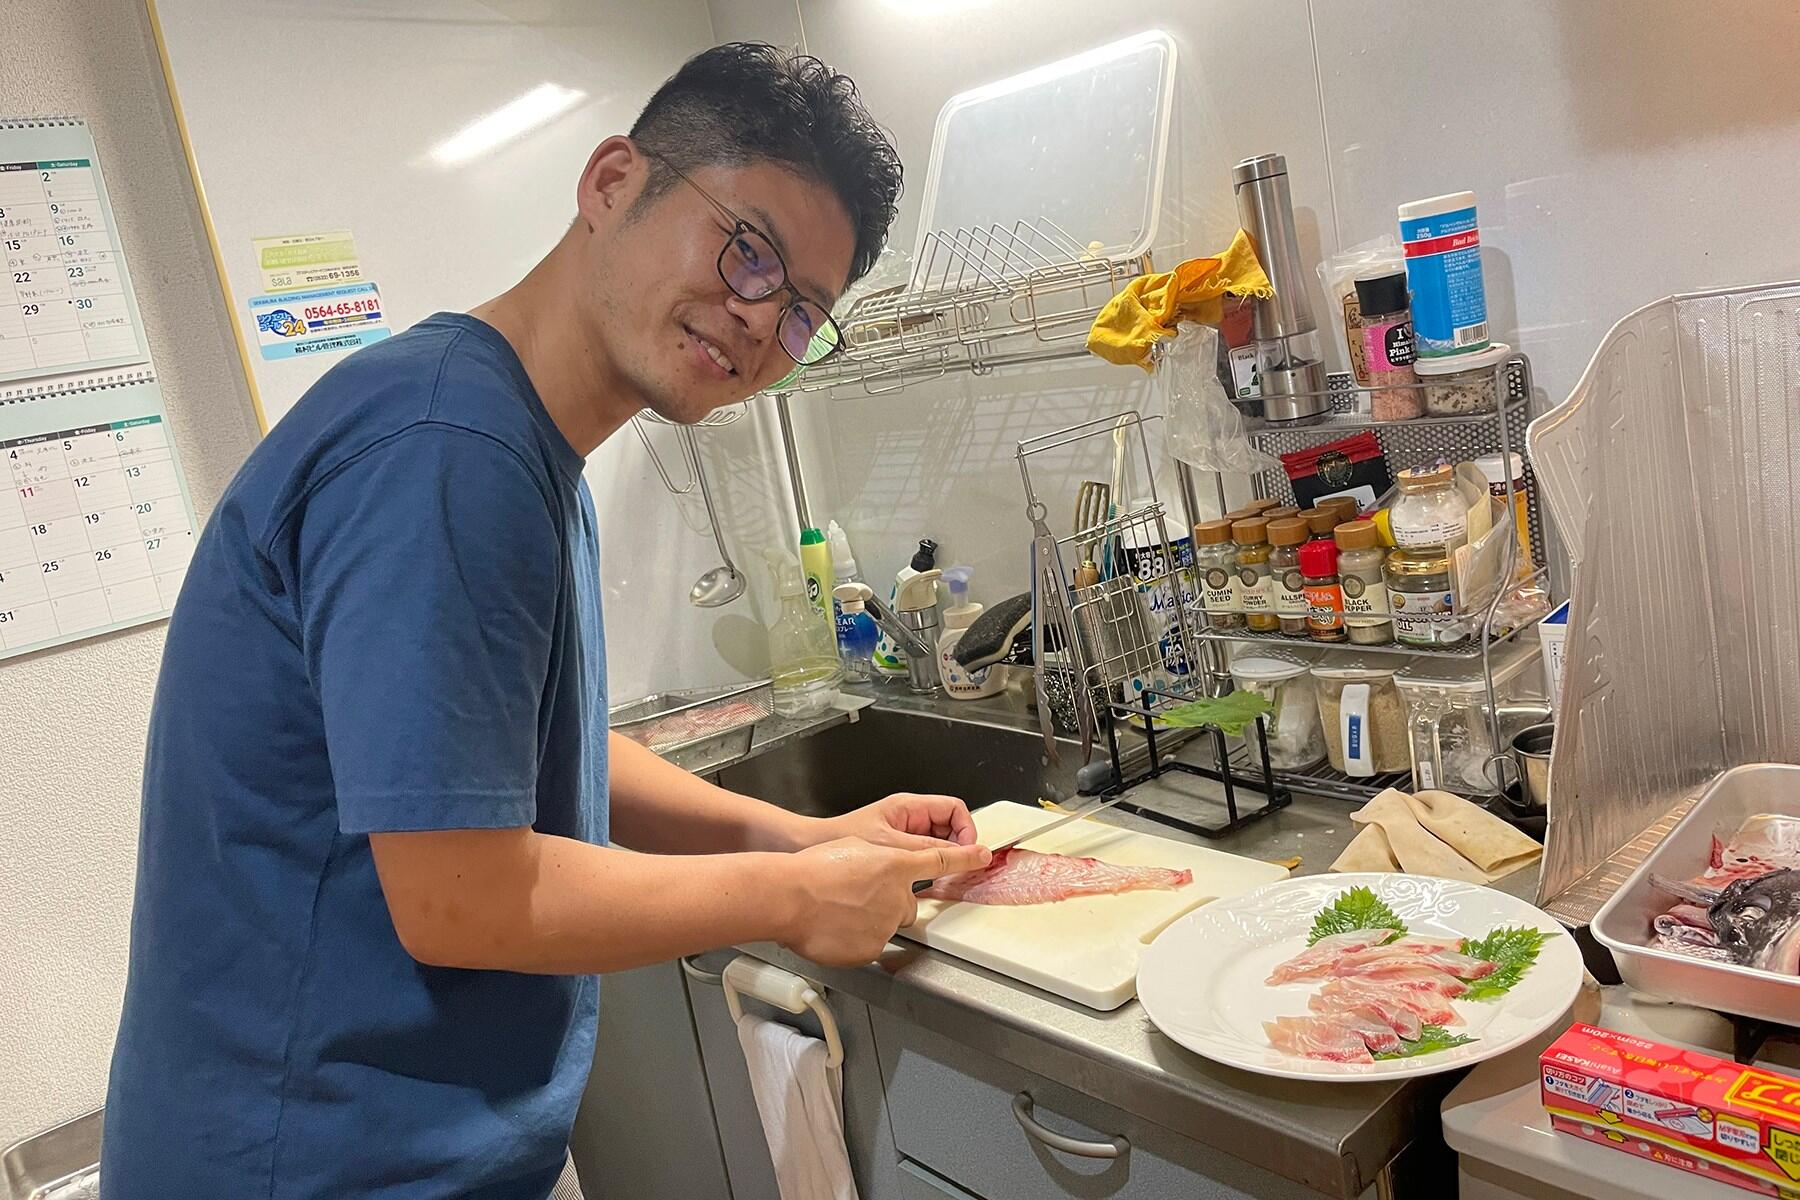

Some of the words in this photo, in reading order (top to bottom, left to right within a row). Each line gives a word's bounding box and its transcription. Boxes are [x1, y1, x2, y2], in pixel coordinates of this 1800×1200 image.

[41, 171, 51, 182] 2
[50, 203, 59, 214] 9
[5, 239, 21, 251] 15
[59, 235, 75, 246] 16
[14, 271, 32, 284] 22
[67, 266, 84, 278] 23
[22, 304, 40, 316] 29
[76, 298, 92, 310] 30
[304, 298, 381, 320] 0564-65-8181
[283, 318, 307, 337] 24
[1396, 328, 1405, 340] I
[1389, 345, 1411, 357] Pink
[80, 427, 97, 435] Friday
[116, 431, 124, 442] 6
[23, 435, 47, 445] Thursday
[63, 440, 72, 451] 5
[10, 450, 18, 460] 4
[126, 467, 141, 479] 13
[74, 476, 90, 488] 12
[20, 486, 35, 498] 11
[136, 502, 152, 515] 20
[84, 513, 100, 525] 19
[31, 523, 48, 537] 18
[146, 538, 161, 551] 27
[95, 548, 112, 562] 26
[42, 560, 59, 574] 25
[1206, 588, 1233, 597] CUMIN
[1209, 595, 1232, 603] SEED
[1344, 598, 1369, 606] BLACK
[1344, 604, 1373, 612] PEPPER
[0, 610, 15, 623] 31
